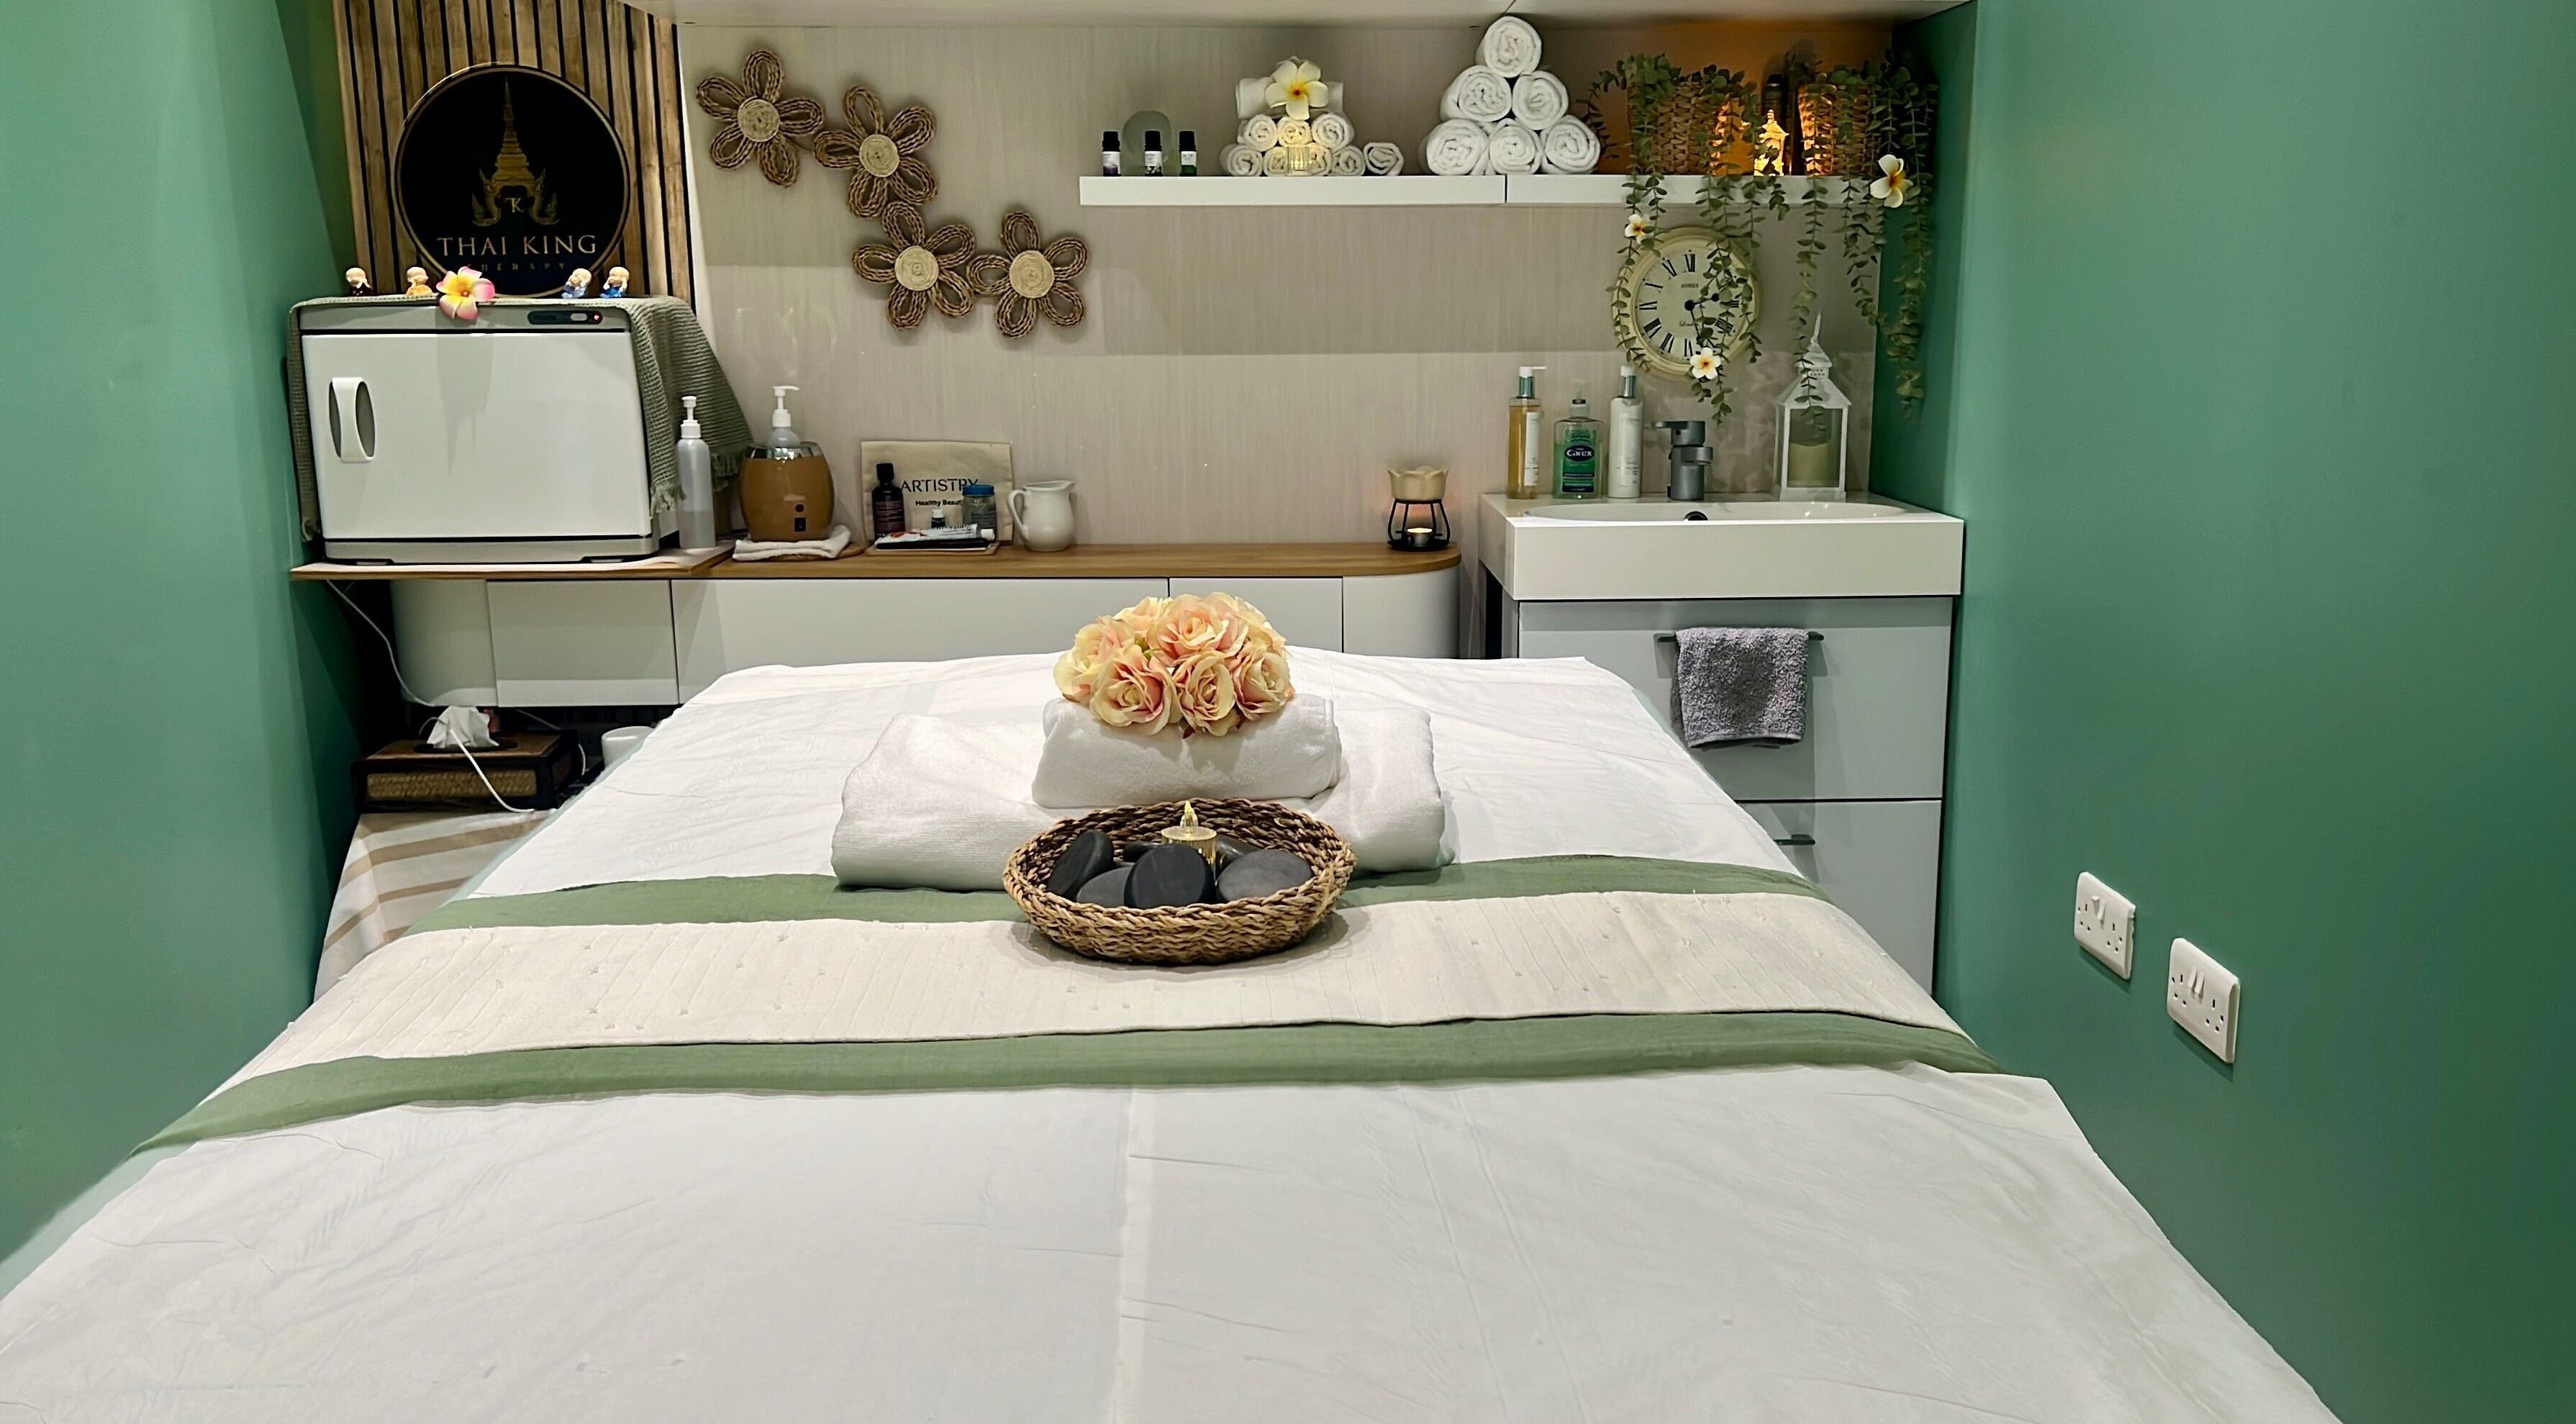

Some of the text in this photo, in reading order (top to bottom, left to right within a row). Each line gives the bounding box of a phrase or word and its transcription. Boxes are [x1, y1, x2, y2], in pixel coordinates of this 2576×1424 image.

[436, 235, 597, 256] THAI KING
[468, 262, 566, 271] HERAPY
